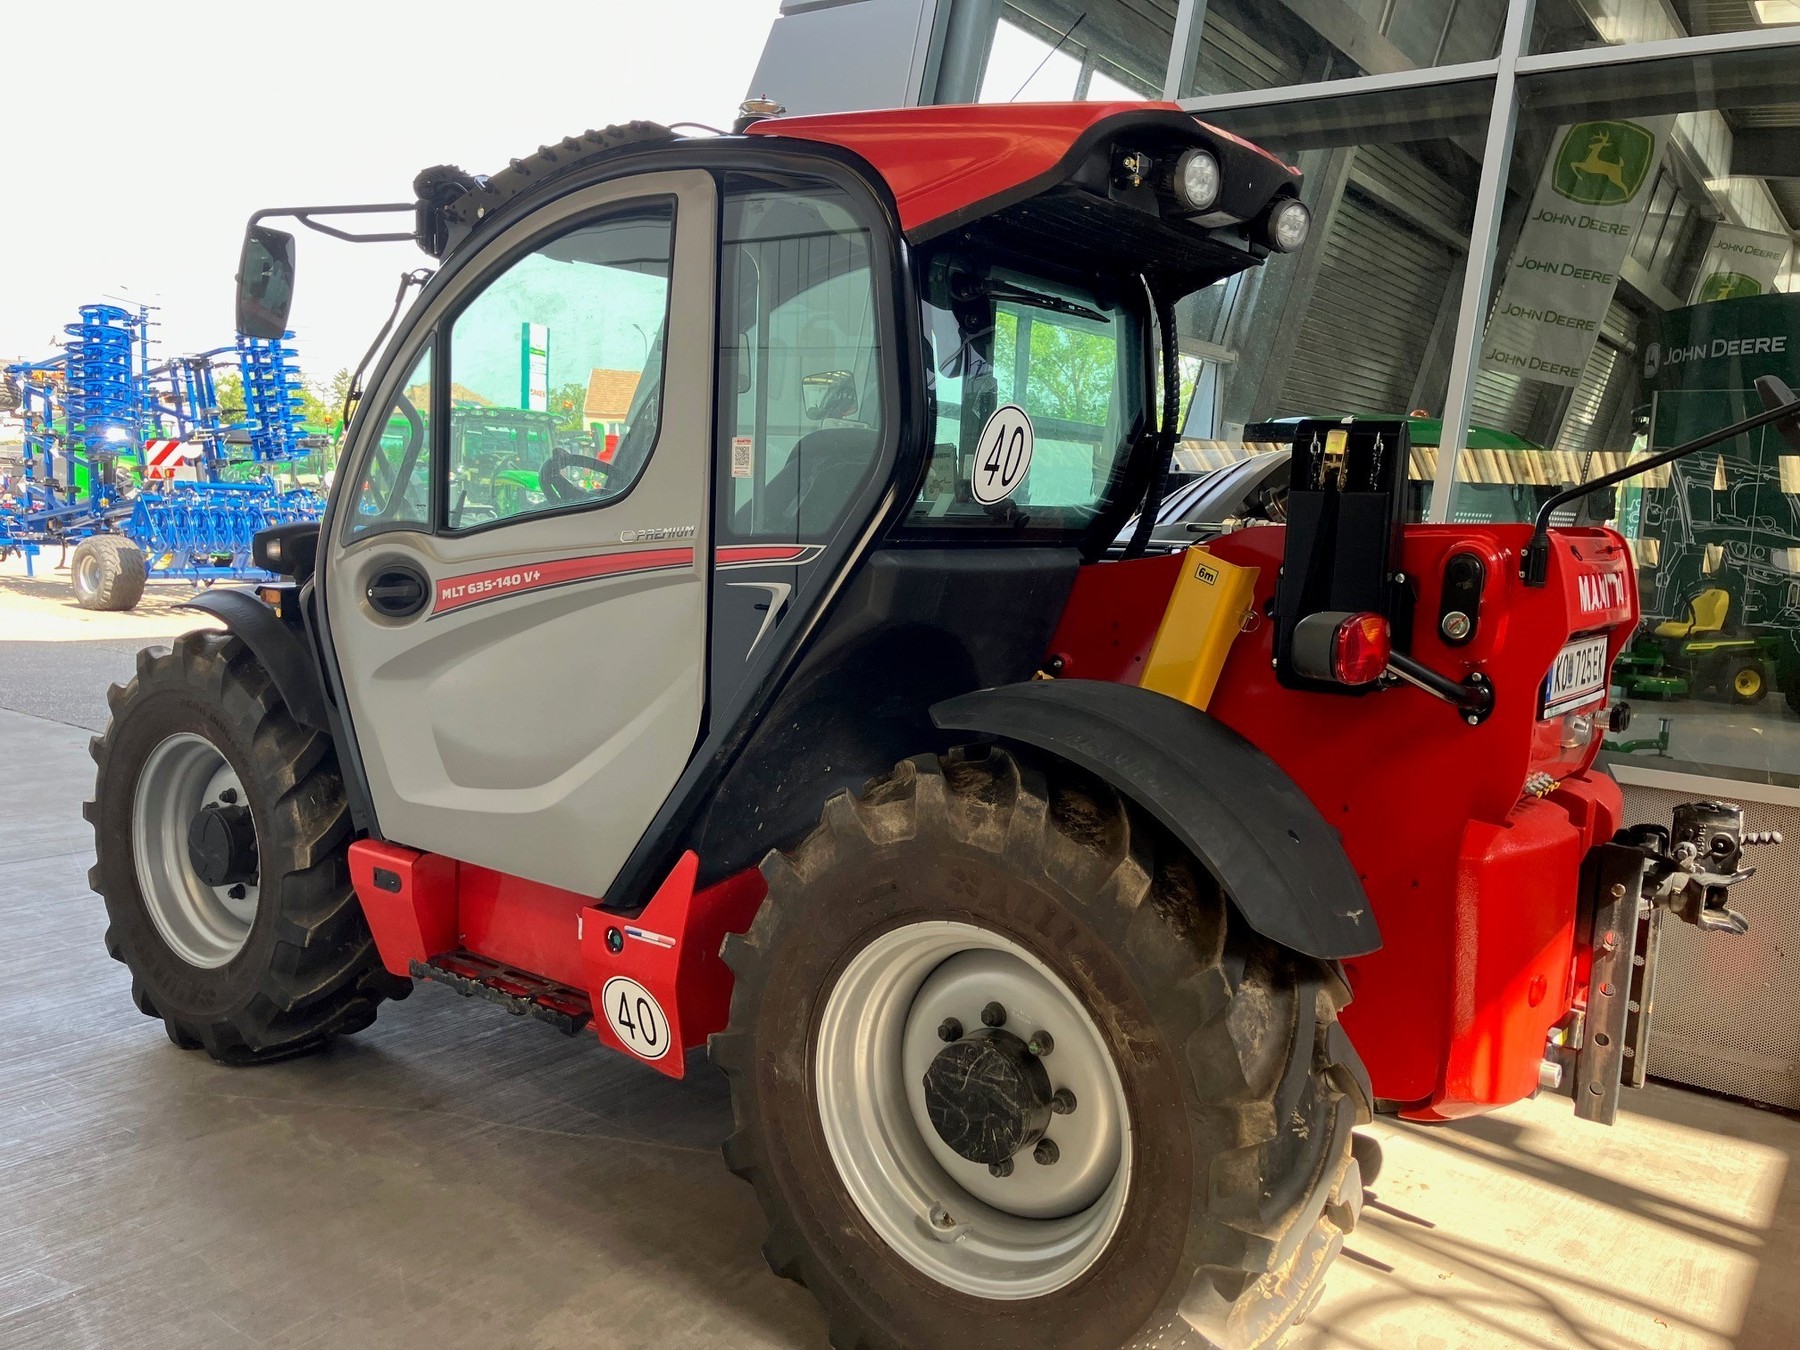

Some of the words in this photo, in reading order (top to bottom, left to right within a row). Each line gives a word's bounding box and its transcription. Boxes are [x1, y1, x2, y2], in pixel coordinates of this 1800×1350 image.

[1532, 208, 1576, 229] JOHN
[1578, 215, 1631, 236] DEERE
[1713, 240, 1744, 253] JOHN
[1744, 245, 1781, 260] DEERE
[1516, 256, 1559, 274] JOHN
[1560, 263, 1613, 284] DEERE
[1501, 303, 1543, 321] JOHN
[1544, 310, 1596, 332] DEERE
[1485, 349, 1527, 367] JOHN
[1528, 356, 1581, 378] DEERE
[1664, 344, 1707, 366] JOHN
[1711, 336, 1787, 358] DEERE
[983, 423, 1024, 487] 40
[636, 525, 695, 541] PREMIUM
[442, 585, 466, 600] MLT
[467, 574, 522, 594] 635-140
[523, 570, 541, 583] V+
[1198, 567, 1214, 582] 6m
[1554, 653, 1569, 693] KO
[618, 991, 657, 1047] 40
